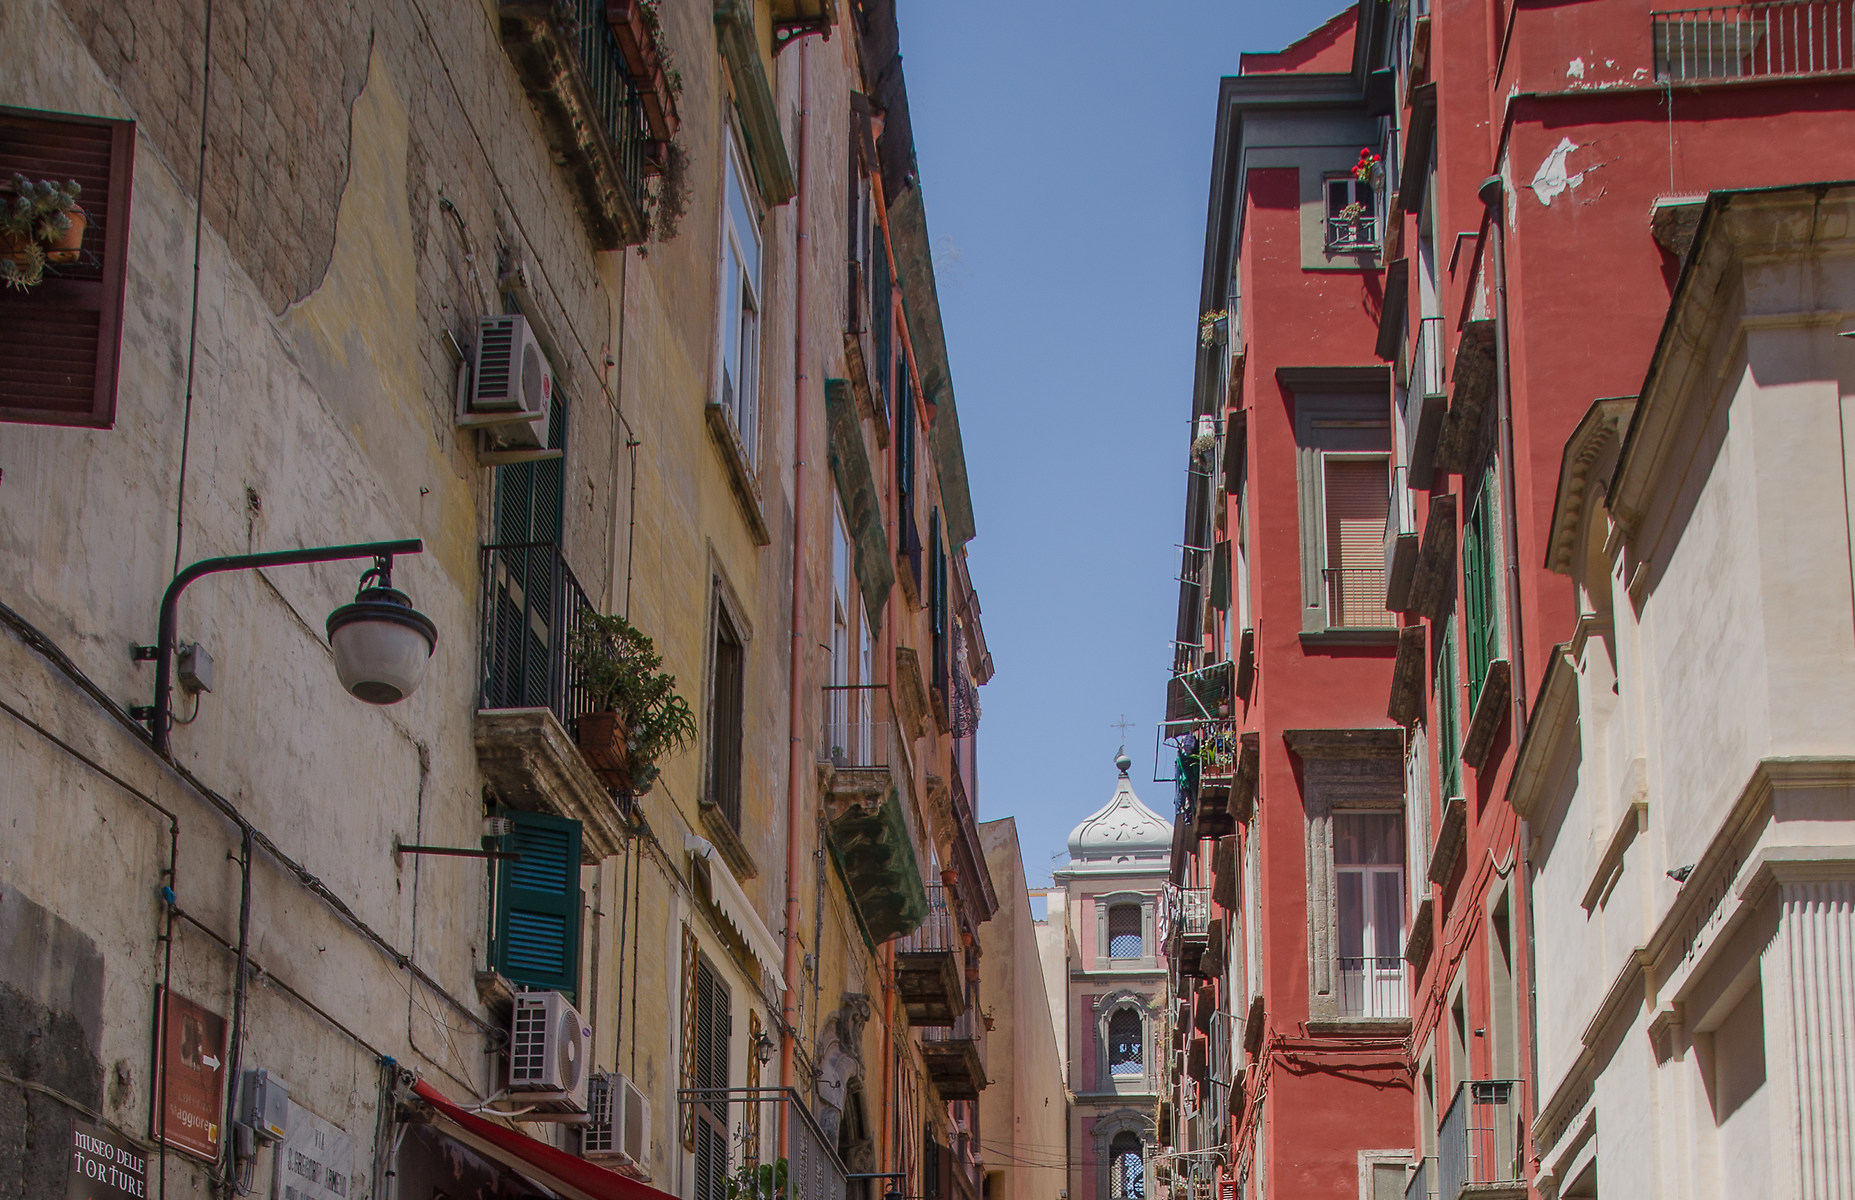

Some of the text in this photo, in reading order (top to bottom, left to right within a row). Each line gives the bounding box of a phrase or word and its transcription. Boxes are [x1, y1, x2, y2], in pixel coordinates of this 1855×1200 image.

[74, 1130, 145, 1175] MUSEO DELLE
[74, 1152, 144, 1198] TORTURE
